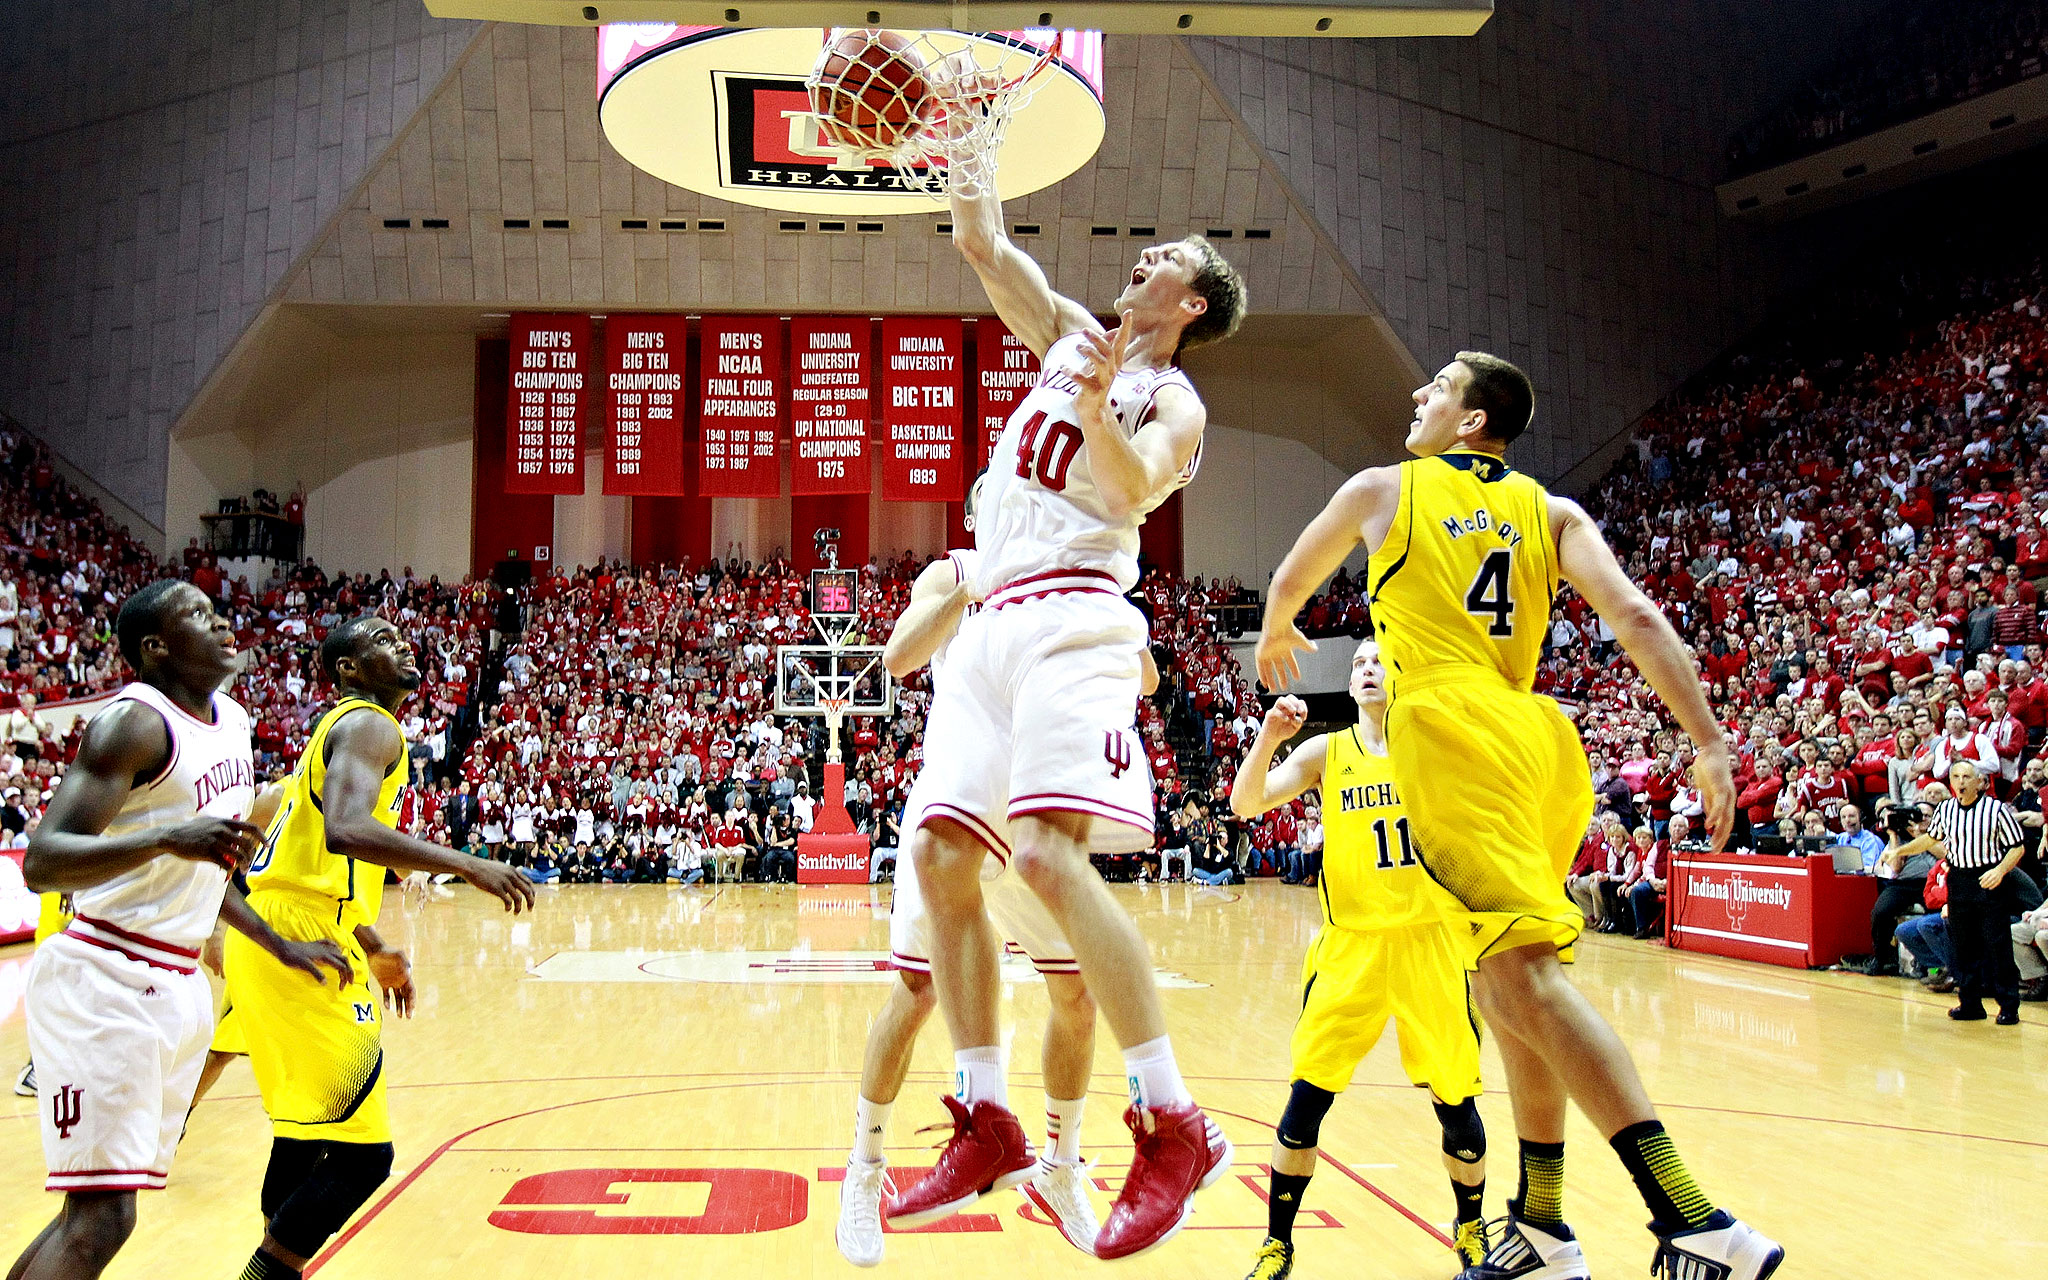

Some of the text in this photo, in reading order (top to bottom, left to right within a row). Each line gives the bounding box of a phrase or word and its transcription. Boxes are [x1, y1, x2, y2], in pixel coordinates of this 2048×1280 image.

[529, 331, 571, 348] MEN'S
[627, 332, 664, 349] MEN'S
[720, 333, 763, 349] MEN'S
[809, 333, 851, 349] INDIANA
[899, 337, 944, 352] INDIANA
[523, 351, 576, 368] BIG TEN
[622, 353, 669, 369] BIG TEN
[719, 355, 763, 374] NCAA
[801, 353, 860, 369] UNIVERSITY
[891, 355, 954, 371] UNIVERSITY
[1004, 350, 1029, 368] NIT
[514, 372, 583, 389] CHAMPIONS
[609, 373, 681, 390] CHAMPIONS
[802, 373, 859, 385] UNDEFEATED
[708, 379, 773, 396] FINAL FOUR
[793, 388, 868, 401] REGULAR SEASON
[988, 389, 1013, 401] 1979
[551, 392, 576, 404] 1958
[616, 393, 673, 405] 1980 1993
[892, 386, 954, 407] BIG TEN
[519, 406, 544, 418] 1928
[616, 407, 673, 419] 1981 2002
[704, 399, 776, 417] APPEARANCES
[550, 420, 575, 432] 1973
[616, 421, 641, 433] 1983
[795, 419, 866, 437] UPI NATIONAL
[891, 424, 955, 440] BASKETBALL
[518, 434, 575, 446] 1953 1974
[616, 435, 641, 447] 1987
[706, 429, 725, 441] 1940
[754, 431, 774, 442] 1992
[518, 448, 575, 460] 1954 1975
[616, 449, 641, 460] 1989
[706, 443, 725, 455] 1953
[754, 444, 774, 456] 2002
[800, 440, 861, 458] CHAMPIONS
[895, 443, 951, 459] CHAMPIONS
[1016, 409, 1084, 492] 40
[517, 462, 574, 474] 1957 1976
[616, 462, 640, 474] 1991
[706, 457, 749, 469] 1973 1987
[817, 461, 845, 478] 1975
[909, 468, 937, 484] 1983
[1441, 509, 1522, 547] McGRY
[821, 587, 849, 611] 35
[1464, 547, 1514, 640] 4
[1371, 816, 1417, 869] 11
[798, 853, 865, 870] Smithville
[1688, 875, 1791, 910] Indiana University
[353, 1003, 375, 1023] M
